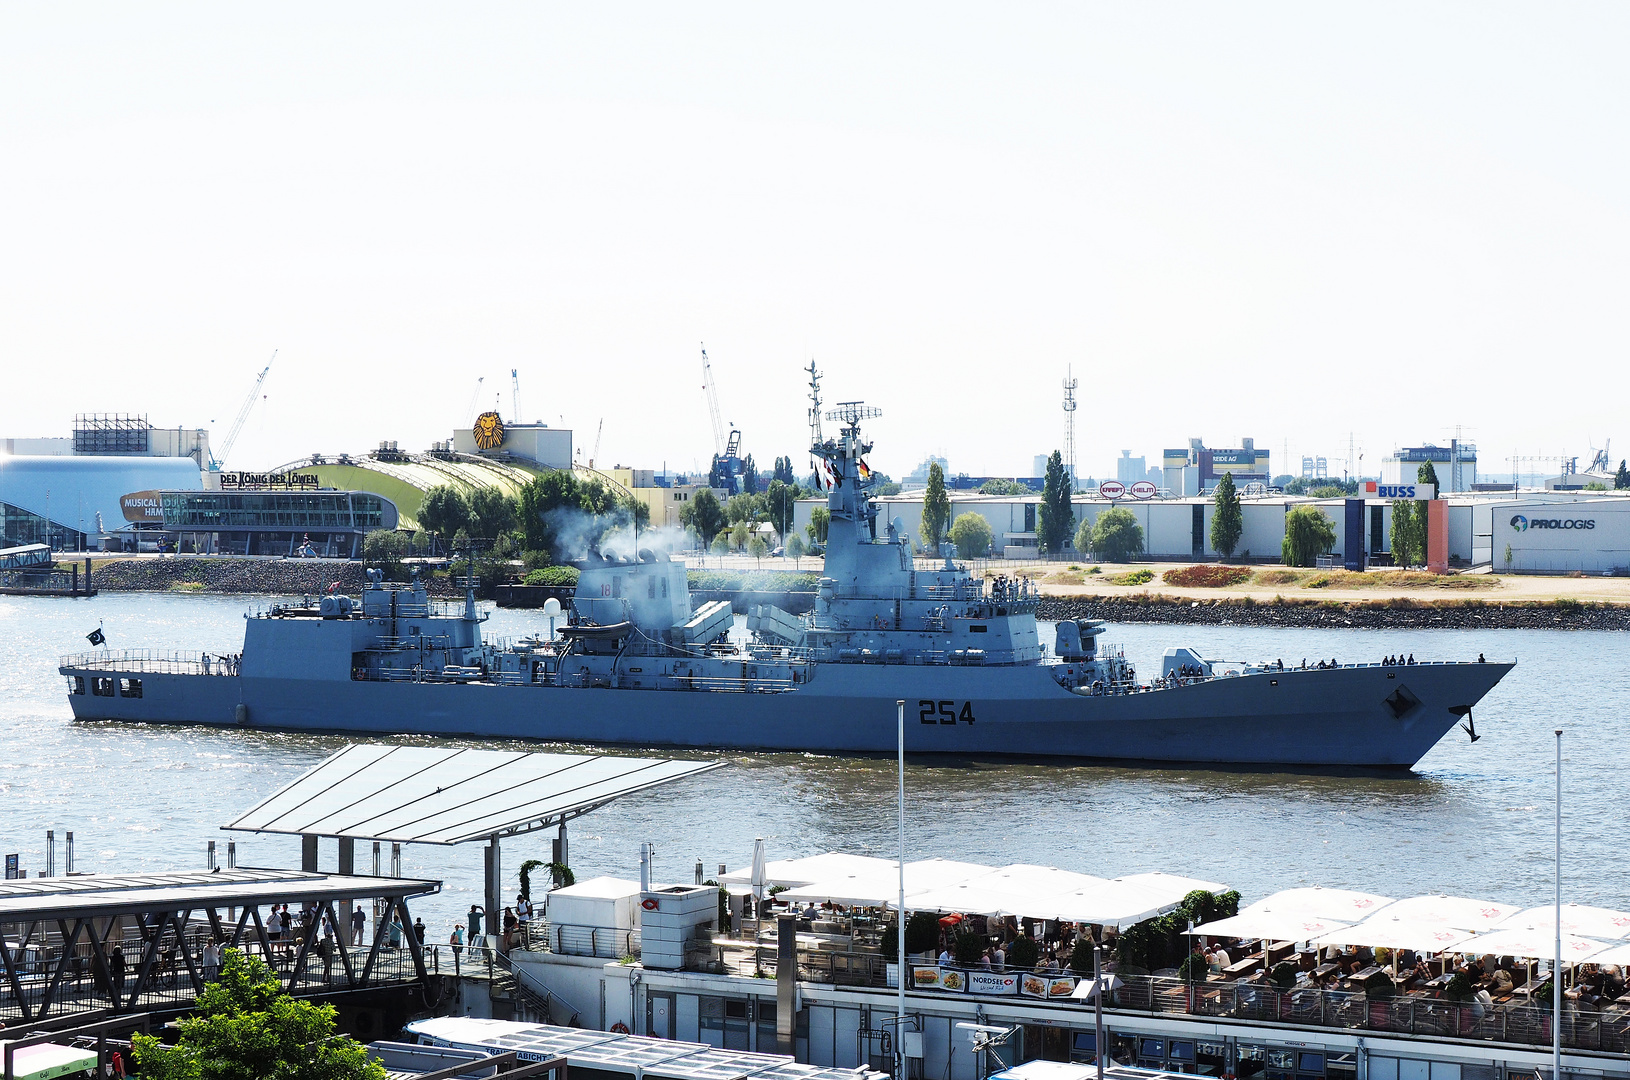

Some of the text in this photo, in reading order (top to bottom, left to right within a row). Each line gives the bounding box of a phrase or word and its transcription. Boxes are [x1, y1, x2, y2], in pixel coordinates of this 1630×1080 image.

[220, 471, 318, 487] DER KÖNIG DER LÖWEN
[1378, 486, 1415, 498] BUSS
[124, 498, 158, 508] MUSICAL
[1530, 519, 1595, 530] PROLOGIS
[601, 583, 611, 597] 18
[918, 700, 976, 726] 254
[972, 976, 1004, 986] NORDSEE
[518, 1052, 548, 1062] ABICHT
